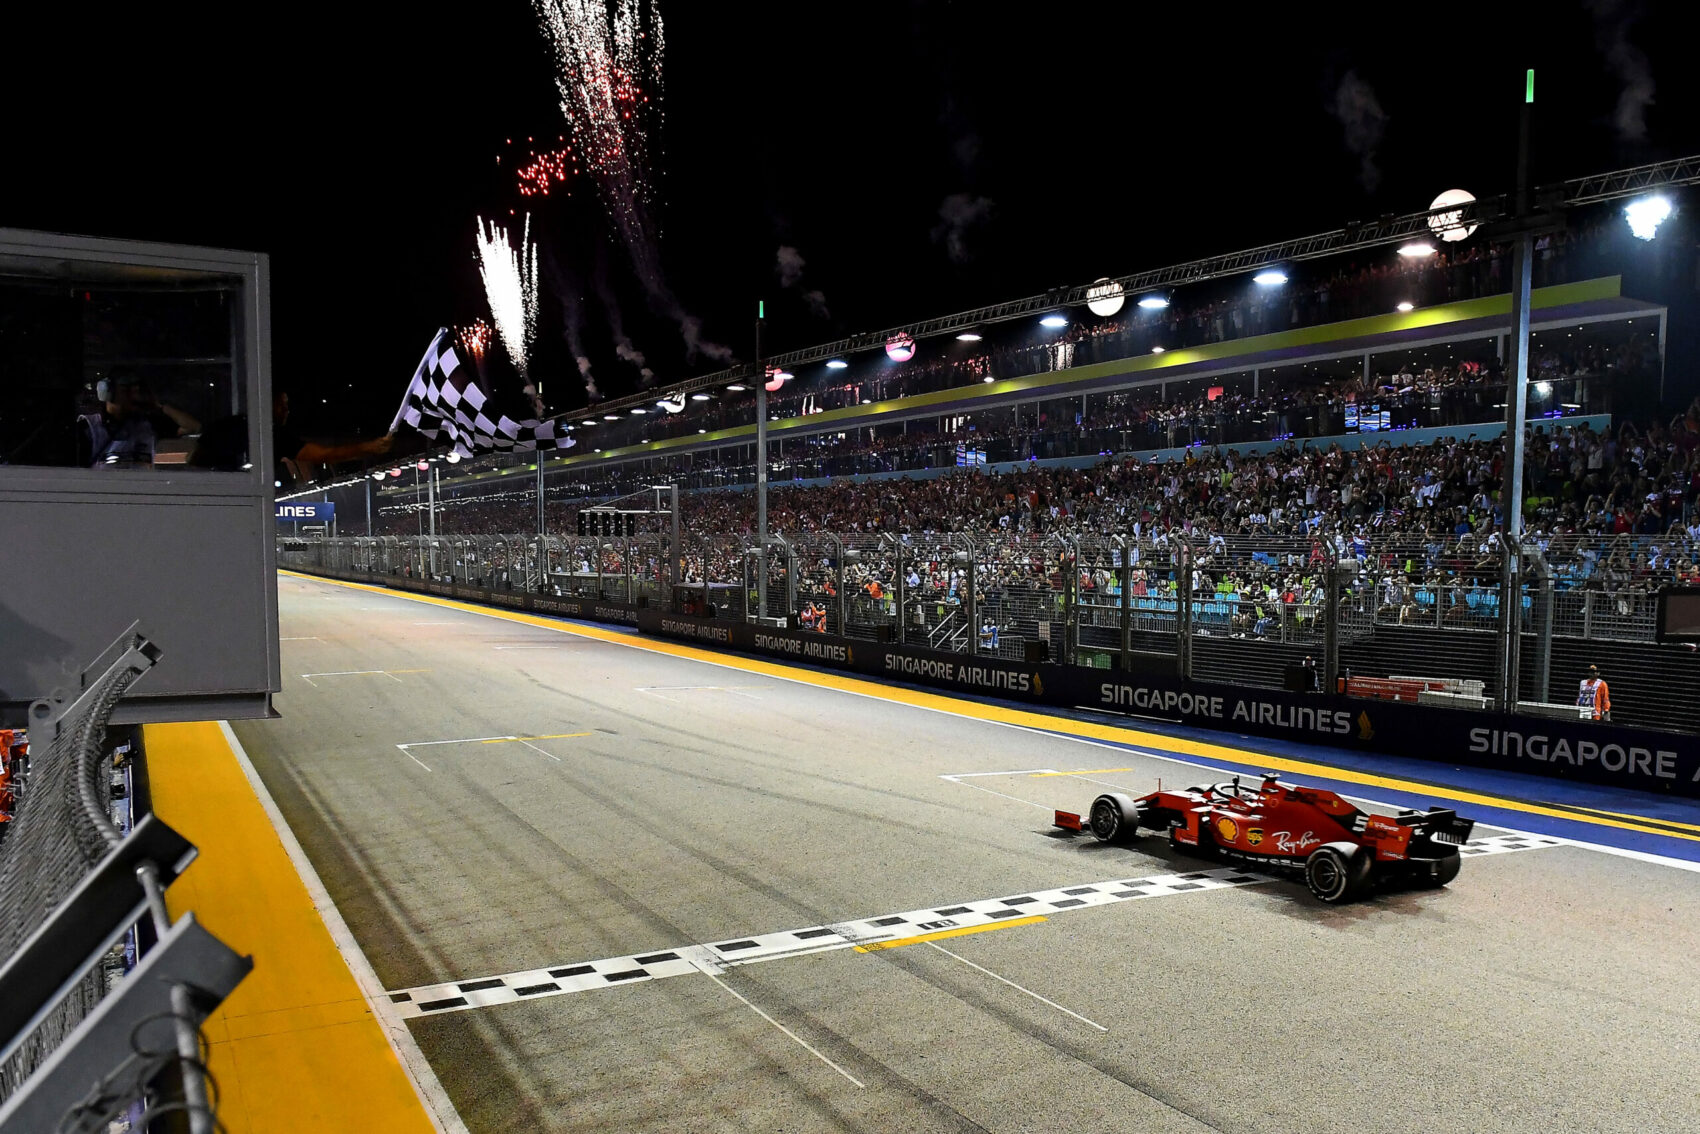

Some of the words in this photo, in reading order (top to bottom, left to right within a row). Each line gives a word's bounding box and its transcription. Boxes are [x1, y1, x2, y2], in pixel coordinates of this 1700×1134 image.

[275, 506, 316, 517] INES
[661, 619, 696, 636] SINGAPORE
[697, 625, 728, 642] AIRLINES
[754, 634, 801, 653] SINGAPORE
[803, 642, 846, 661] AIRLINES
[885, 653, 953, 680] SINGAPORE
[957, 665, 1030, 691] AIRLINES
[1101, 683, 1224, 718] SINGAPORE
[1232, 700, 1350, 734] AIRLINES
[1469, 727, 1678, 779] SINGAPORE
